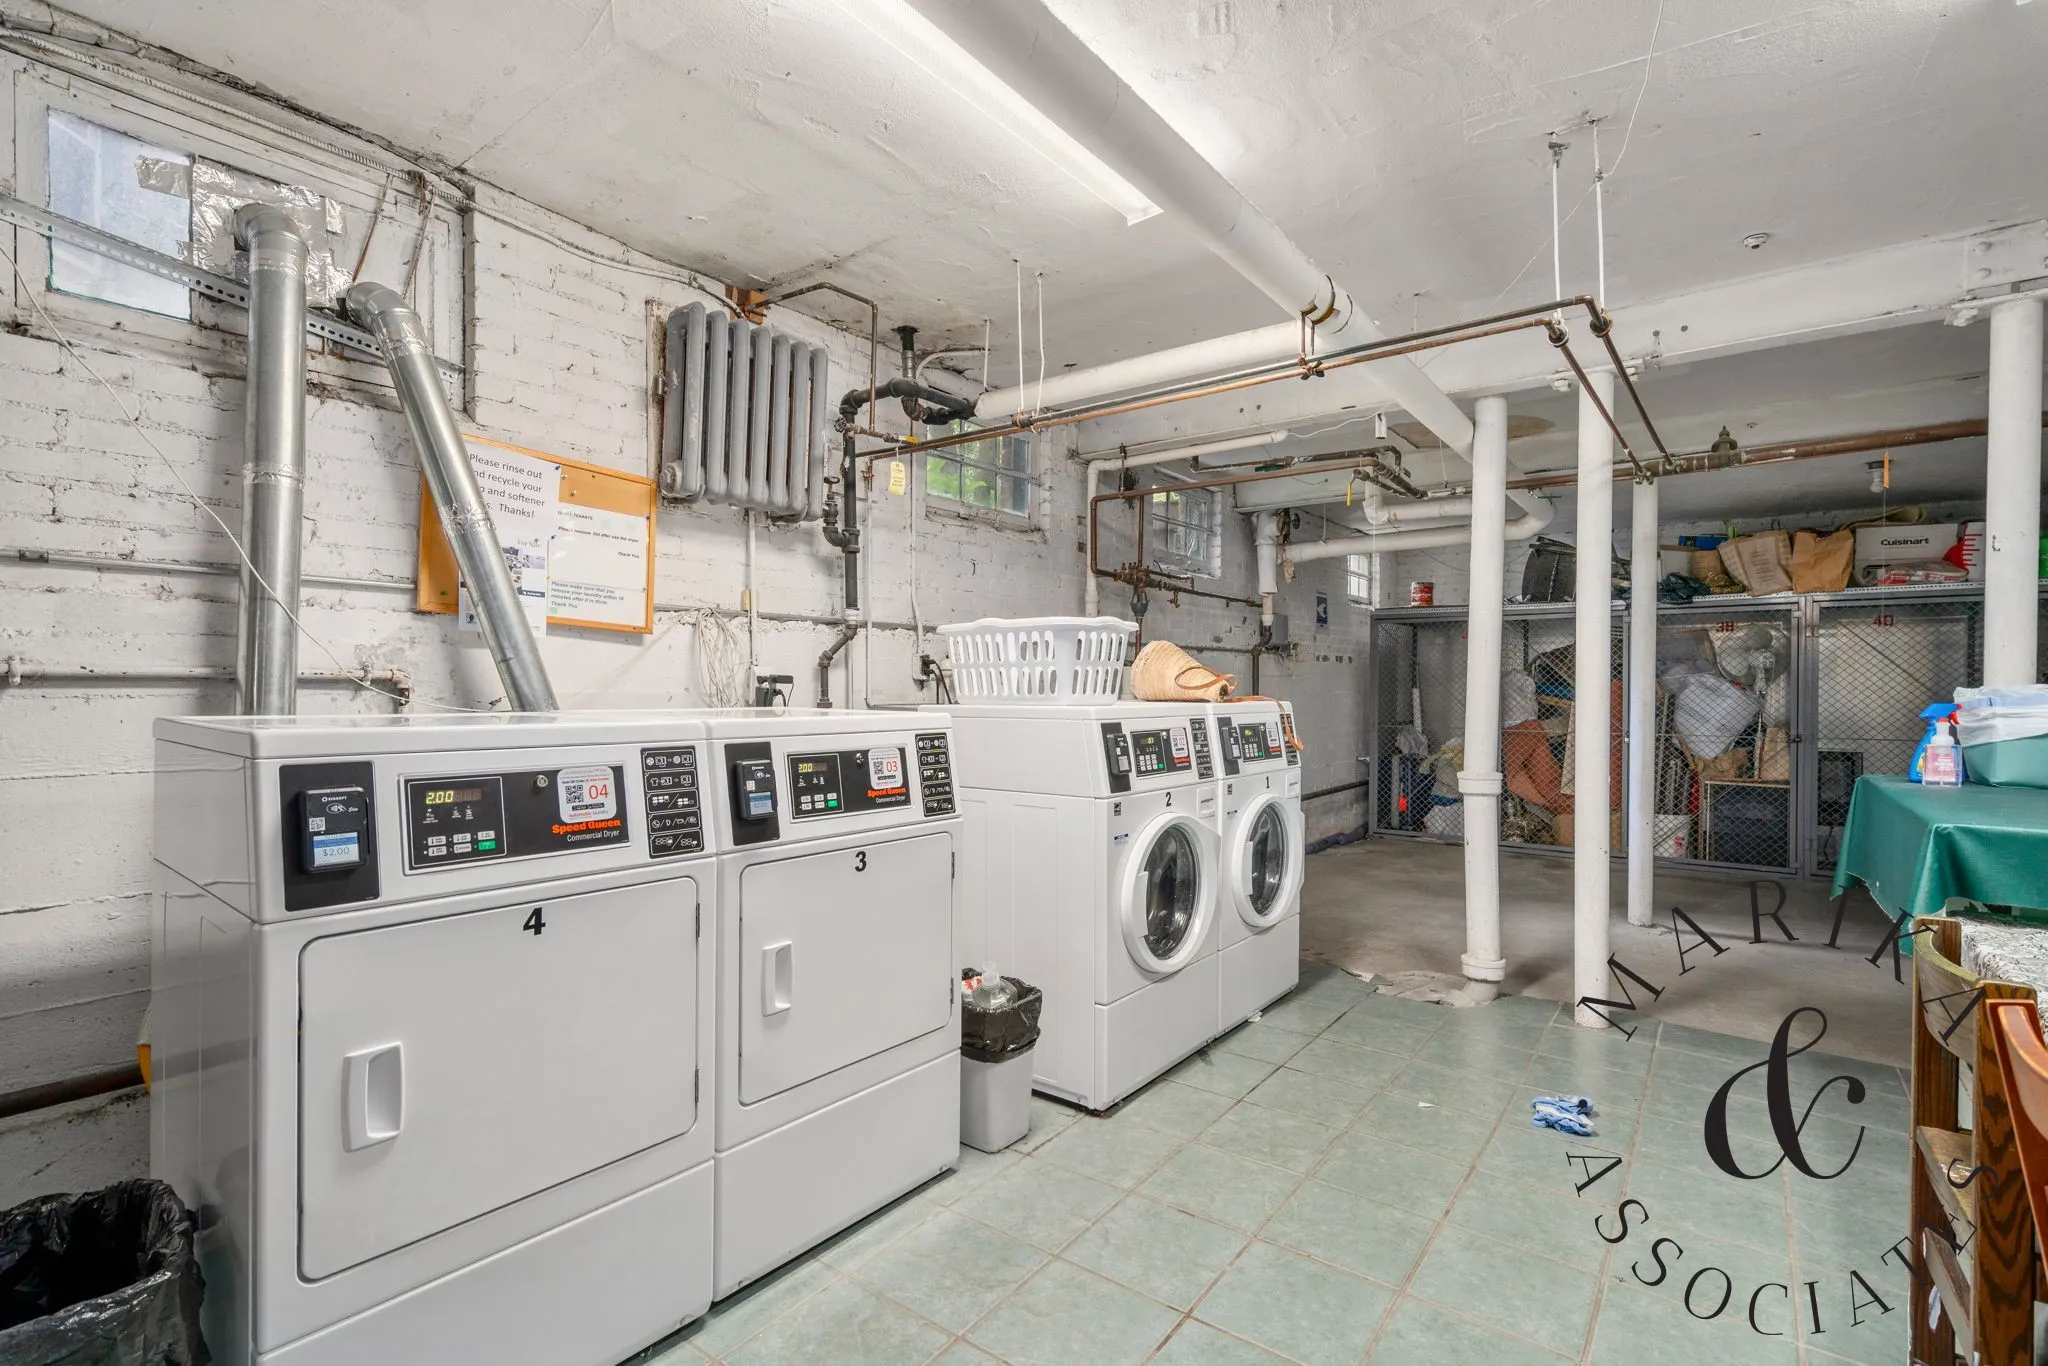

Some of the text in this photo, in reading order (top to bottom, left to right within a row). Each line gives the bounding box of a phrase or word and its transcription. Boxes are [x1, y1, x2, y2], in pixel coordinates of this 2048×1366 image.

[469, 453, 543, 479] Please rinse out
[474, 470, 543, 493] nd recycle your
[487, 486, 506, 497] and
[508, 491, 545, 507] softener
[499, 503, 535, 519] Thanks!
[573, 512, 593, 521] TENANTS
[574, 528, 591, 536] remove
[1881, 537, 1930, 546] Cuisinart
[886, 760, 898, 773] 03
[1265, 775, 1271, 789] 1
[426, 790, 455, 805] 2.00
[589, 784, 609, 800] 04
[867, 787, 906, 798] Speed Queen
[1165, 791, 1172, 808] 2
[552, 819, 621, 835] Speed Queen
[567, 829, 620, 842] Commercial Dryer
[322, 846, 350, 857] $2.00
[854, 851, 867, 873] 3
[523, 907, 546, 936] 4
